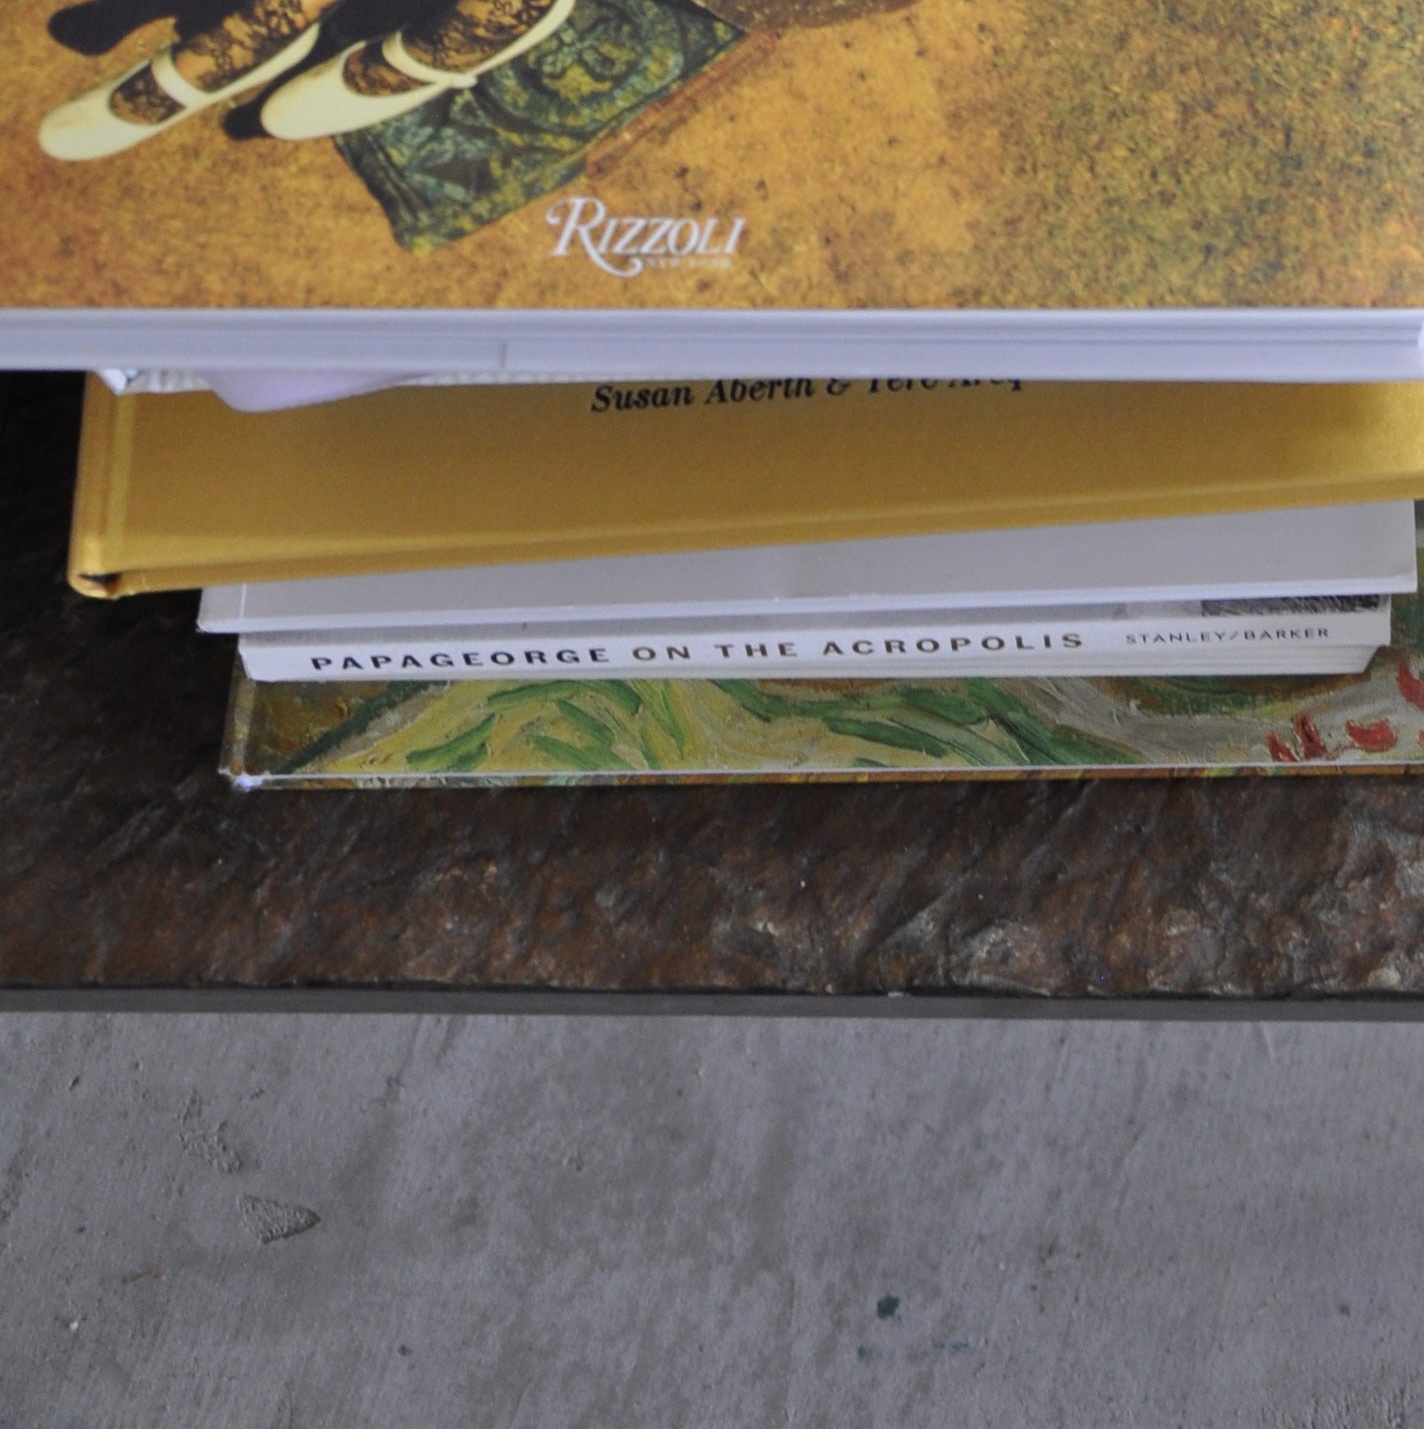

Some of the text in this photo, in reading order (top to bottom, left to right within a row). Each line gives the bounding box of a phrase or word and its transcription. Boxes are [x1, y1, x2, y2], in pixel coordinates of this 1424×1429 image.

[591, 382, 693, 413] Susan
[311, 646, 609, 672] PAPAGEORGE
[631, 644, 692, 662] ON
[714, 640, 797, 658] THE
[822, 633, 1084, 656] ACROPOLIS
